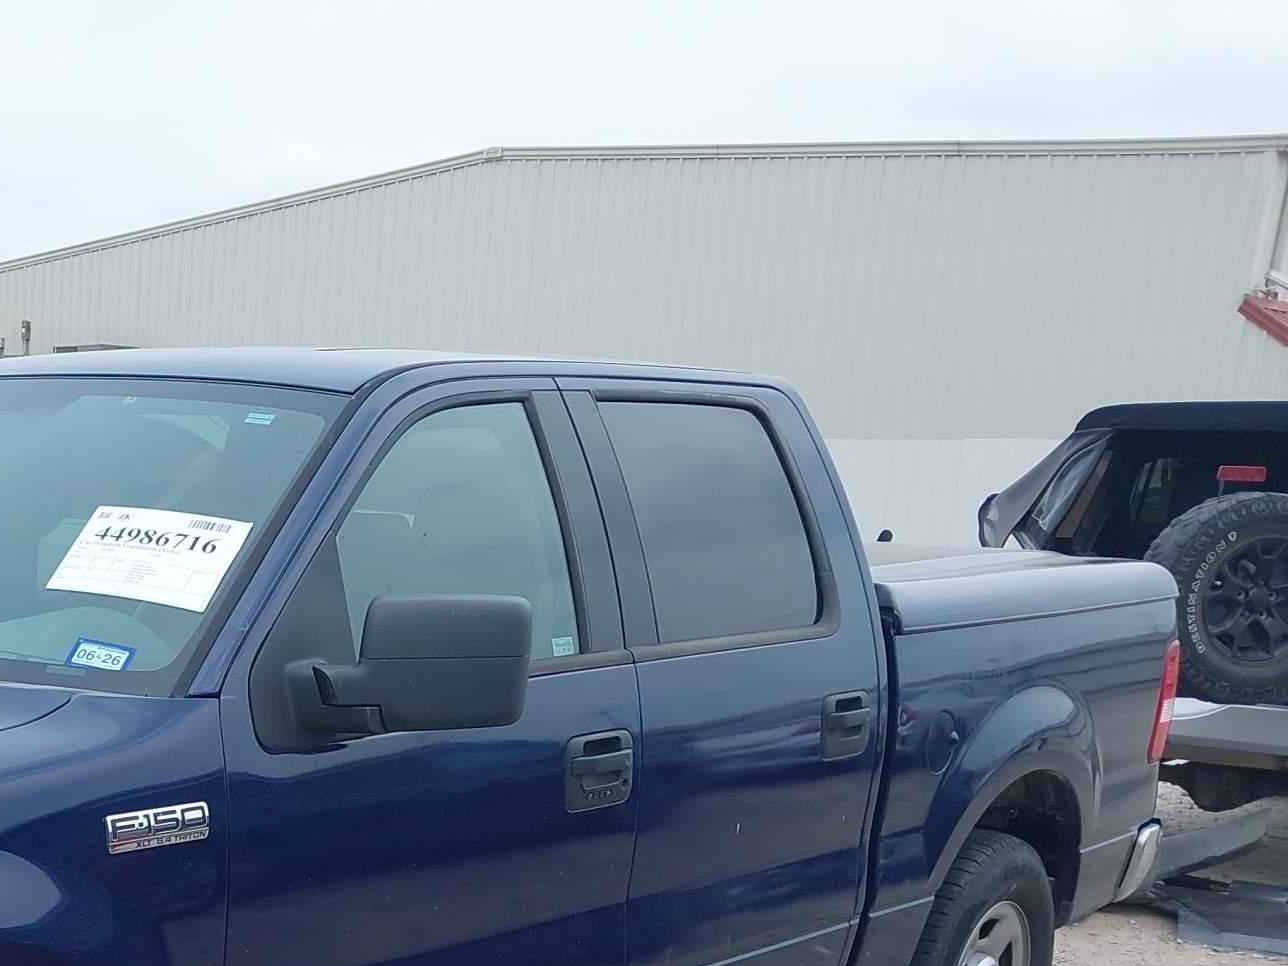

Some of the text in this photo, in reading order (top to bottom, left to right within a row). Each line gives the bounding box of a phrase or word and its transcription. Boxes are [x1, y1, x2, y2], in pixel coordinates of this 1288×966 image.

[94, 525, 224, 554] 44986716
[76, 648, 122, 666] 06 26
[136, 839, 151, 849] XLT
